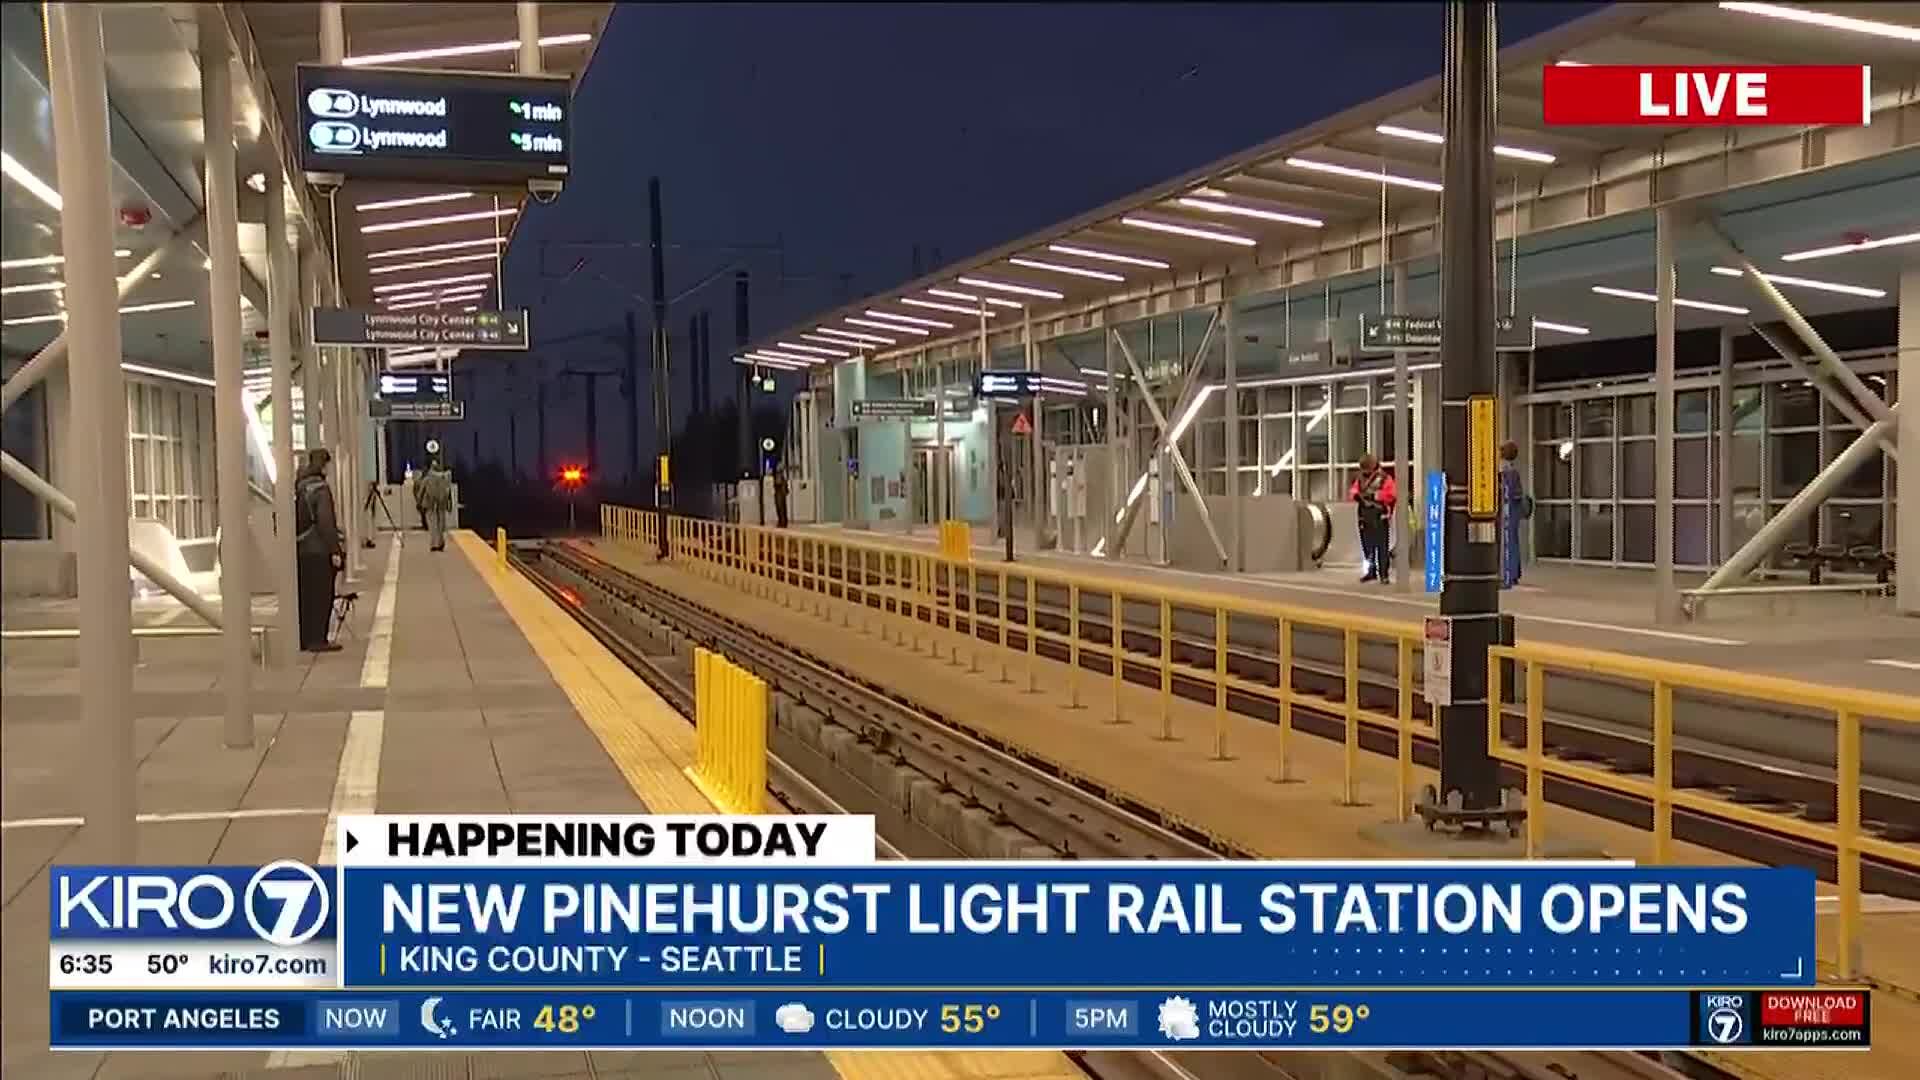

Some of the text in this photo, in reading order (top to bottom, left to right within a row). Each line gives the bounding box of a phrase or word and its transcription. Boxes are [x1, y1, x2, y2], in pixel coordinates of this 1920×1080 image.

[361, 96, 446, 119] Lynnwood
[533, 103, 562, 121] min
[362, 127, 447, 150] Lynnwood
[533, 135, 562, 152] min
